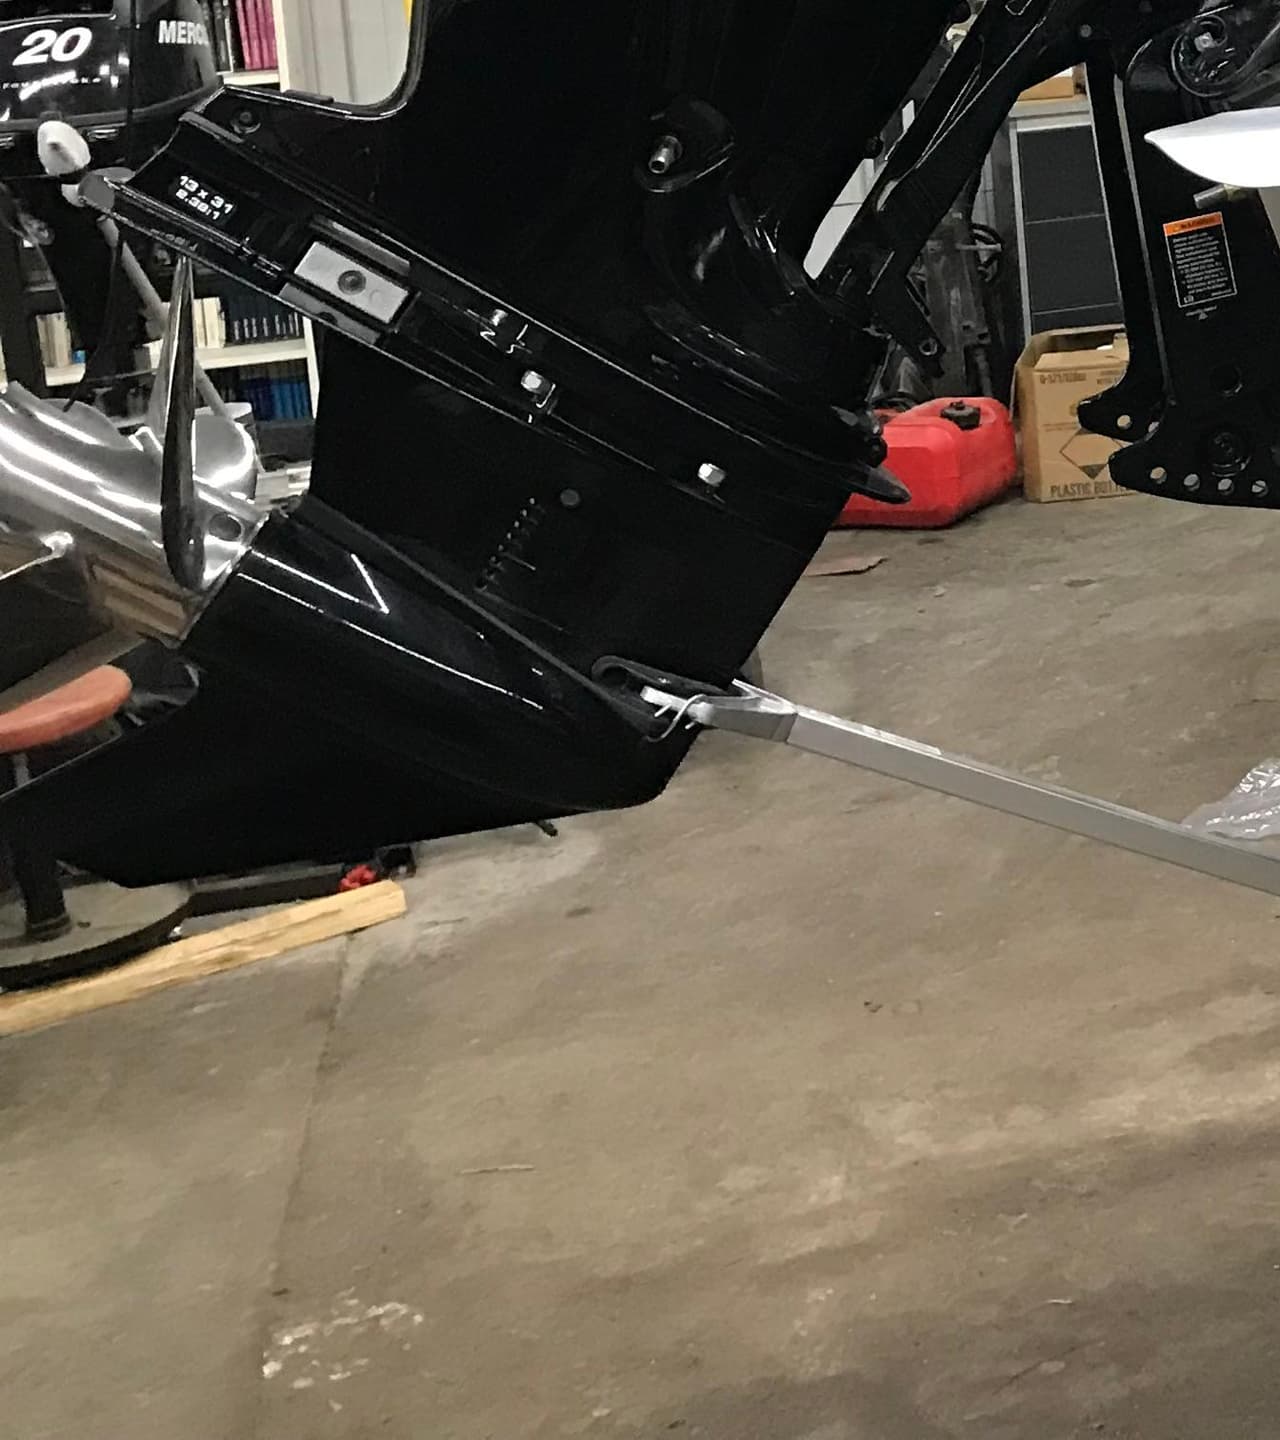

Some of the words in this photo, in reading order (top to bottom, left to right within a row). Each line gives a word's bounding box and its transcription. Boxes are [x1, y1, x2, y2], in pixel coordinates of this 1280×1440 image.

[12, 27, 93, 66] 20
[178, 175, 200, 193] 13
[210, 196, 234, 215] 31
